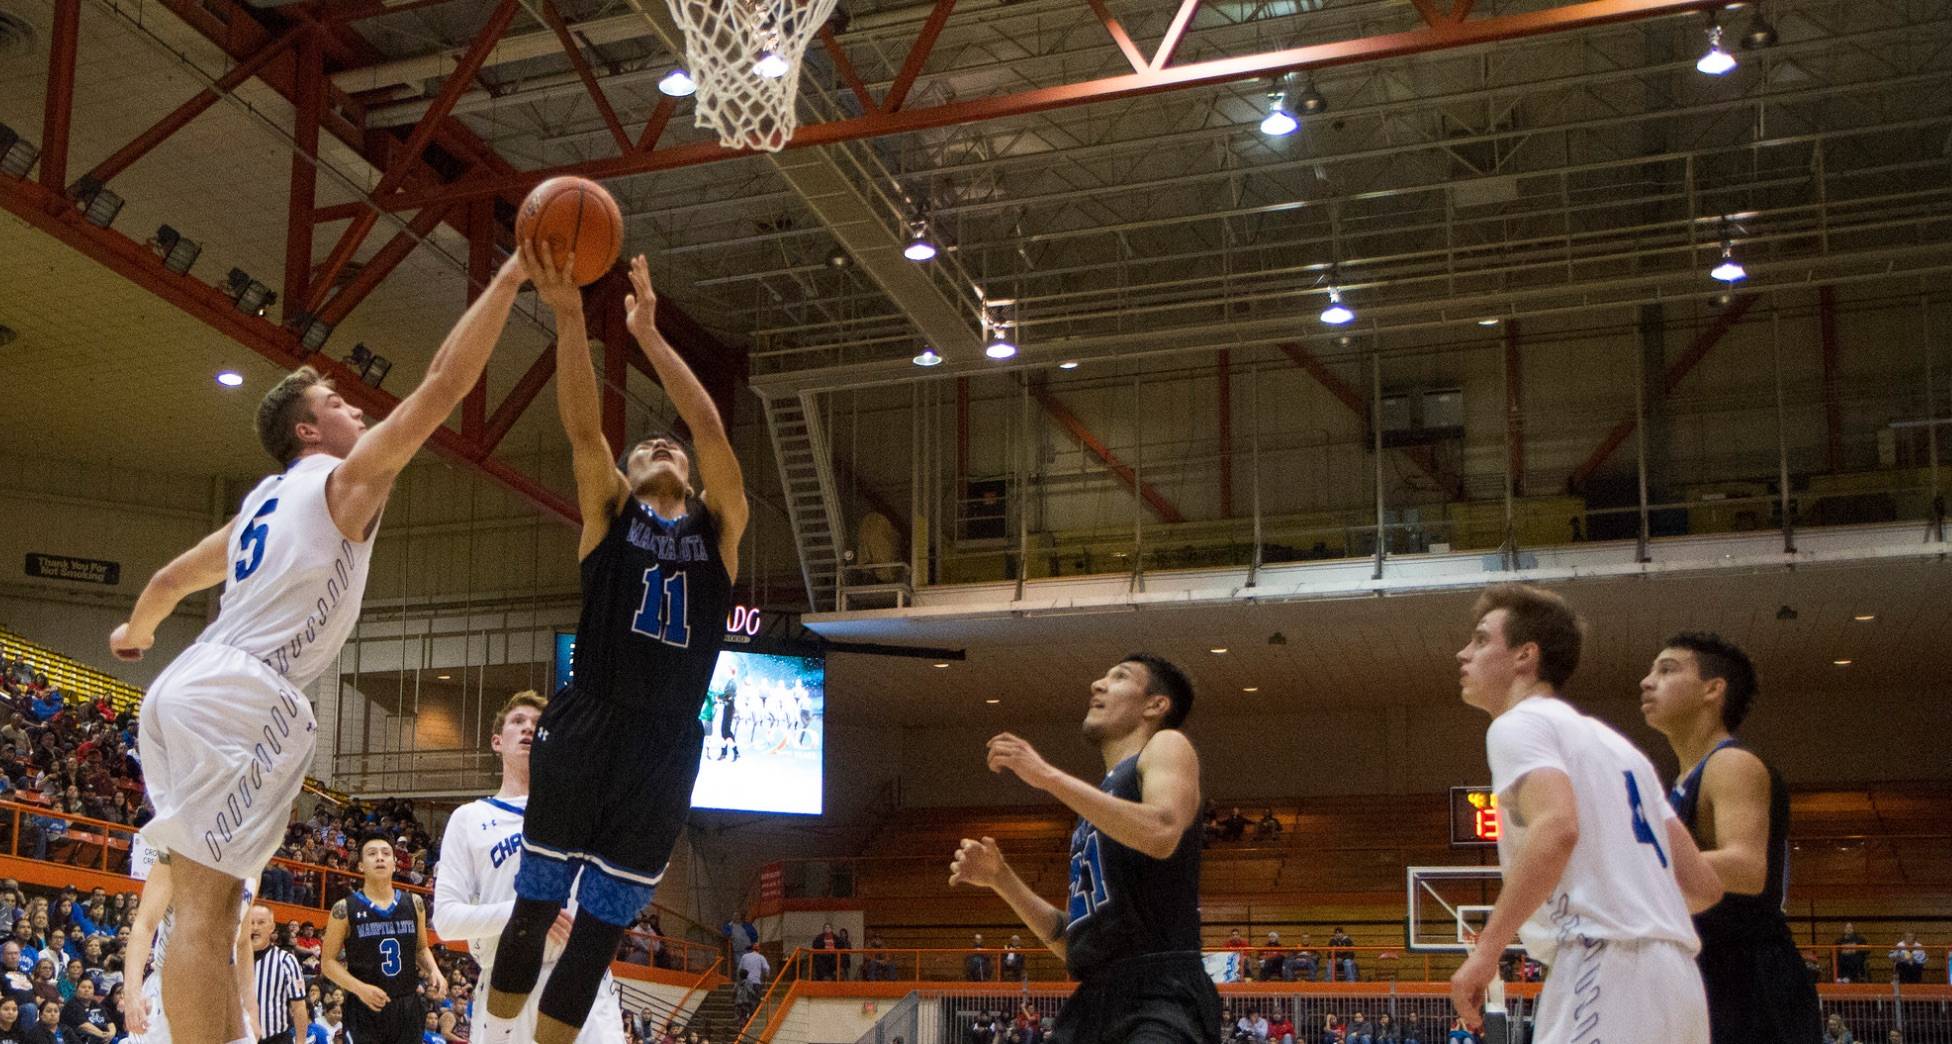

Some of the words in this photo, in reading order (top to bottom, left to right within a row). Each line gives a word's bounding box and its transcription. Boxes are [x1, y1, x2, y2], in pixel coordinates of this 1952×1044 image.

[38, 557, 69, 568] Thank
[71, 560, 89, 569] You
[92, 562, 108, 572] For
[235, 498, 279, 583] 5
[41, 566, 58, 575] Not
[60, 567, 105, 581] Smoking
[631, 563, 690, 648] 11
[1622, 769, 1668, 869] 4
[379, 937, 401, 976] 3
